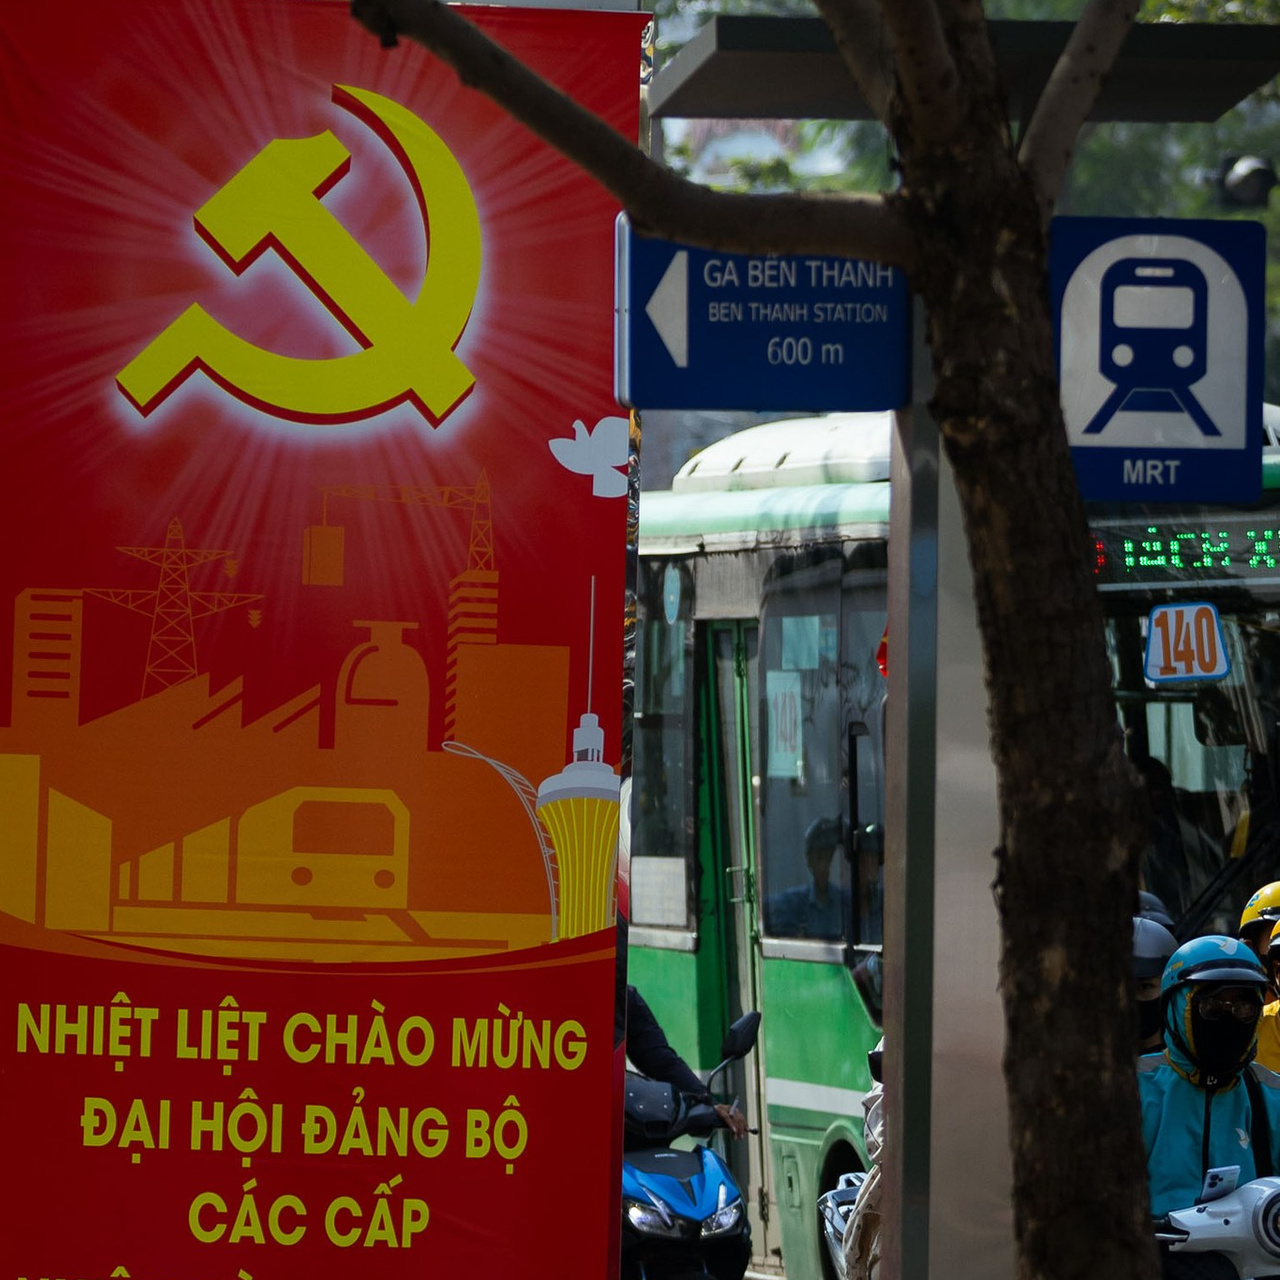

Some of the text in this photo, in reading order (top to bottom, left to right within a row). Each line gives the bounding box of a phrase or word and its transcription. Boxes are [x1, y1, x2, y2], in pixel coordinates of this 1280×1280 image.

[703, 259, 740, 288] GA
[708, 302, 888, 323] BEN THANH STATION
[767, 336, 844, 365] 600 m
[1123, 459, 1180, 484] MRT
[1154, 606, 1218, 676] 140
[16, 991, 588, 1076] NHIỆT LIỆT CHÀO MỪNG
[80, 1086, 528, 1175] ĐẠI HỘI ĐẢNG BỘ
[188, 1173, 430, 1248] CÁC CẤP
